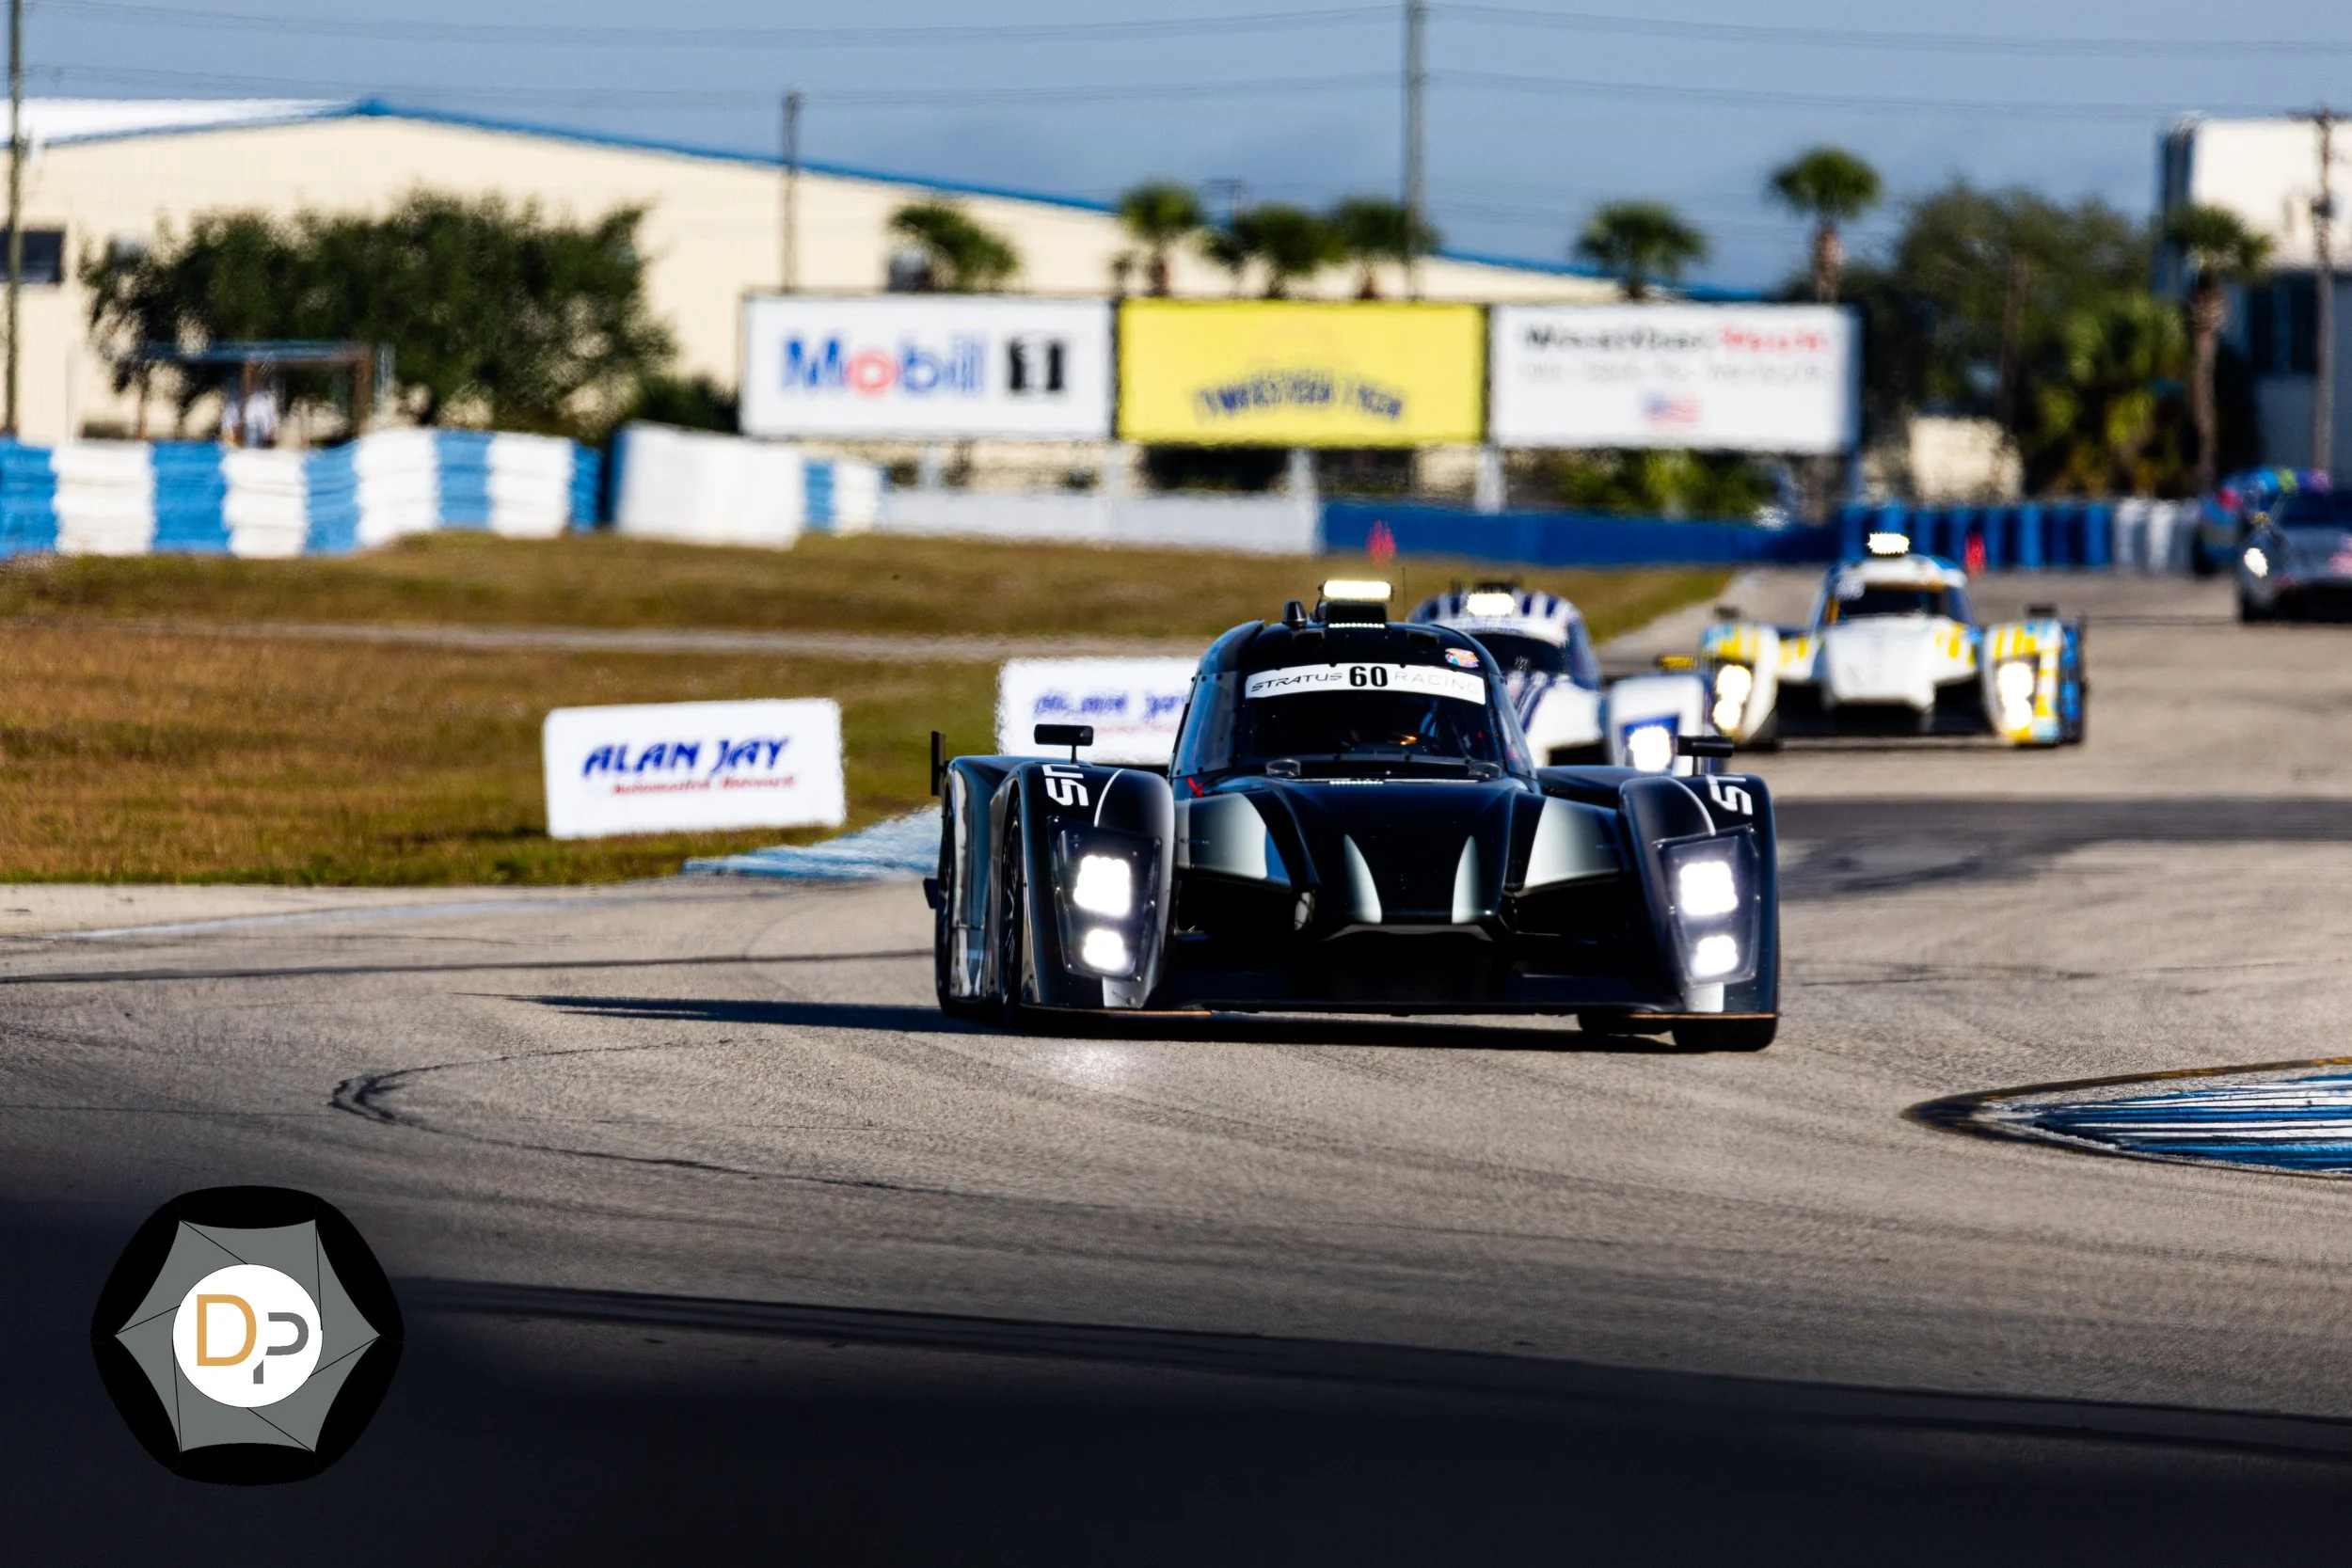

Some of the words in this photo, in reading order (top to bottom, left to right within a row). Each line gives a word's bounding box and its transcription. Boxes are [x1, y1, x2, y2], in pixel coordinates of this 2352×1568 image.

[782, 334, 986, 392] Mobil
[1250, 673, 1343, 692] STRATUS
[1349, 665, 1388, 688] 60
[582, 741, 701, 778] ALAN
[710, 737, 791, 778] JAY
